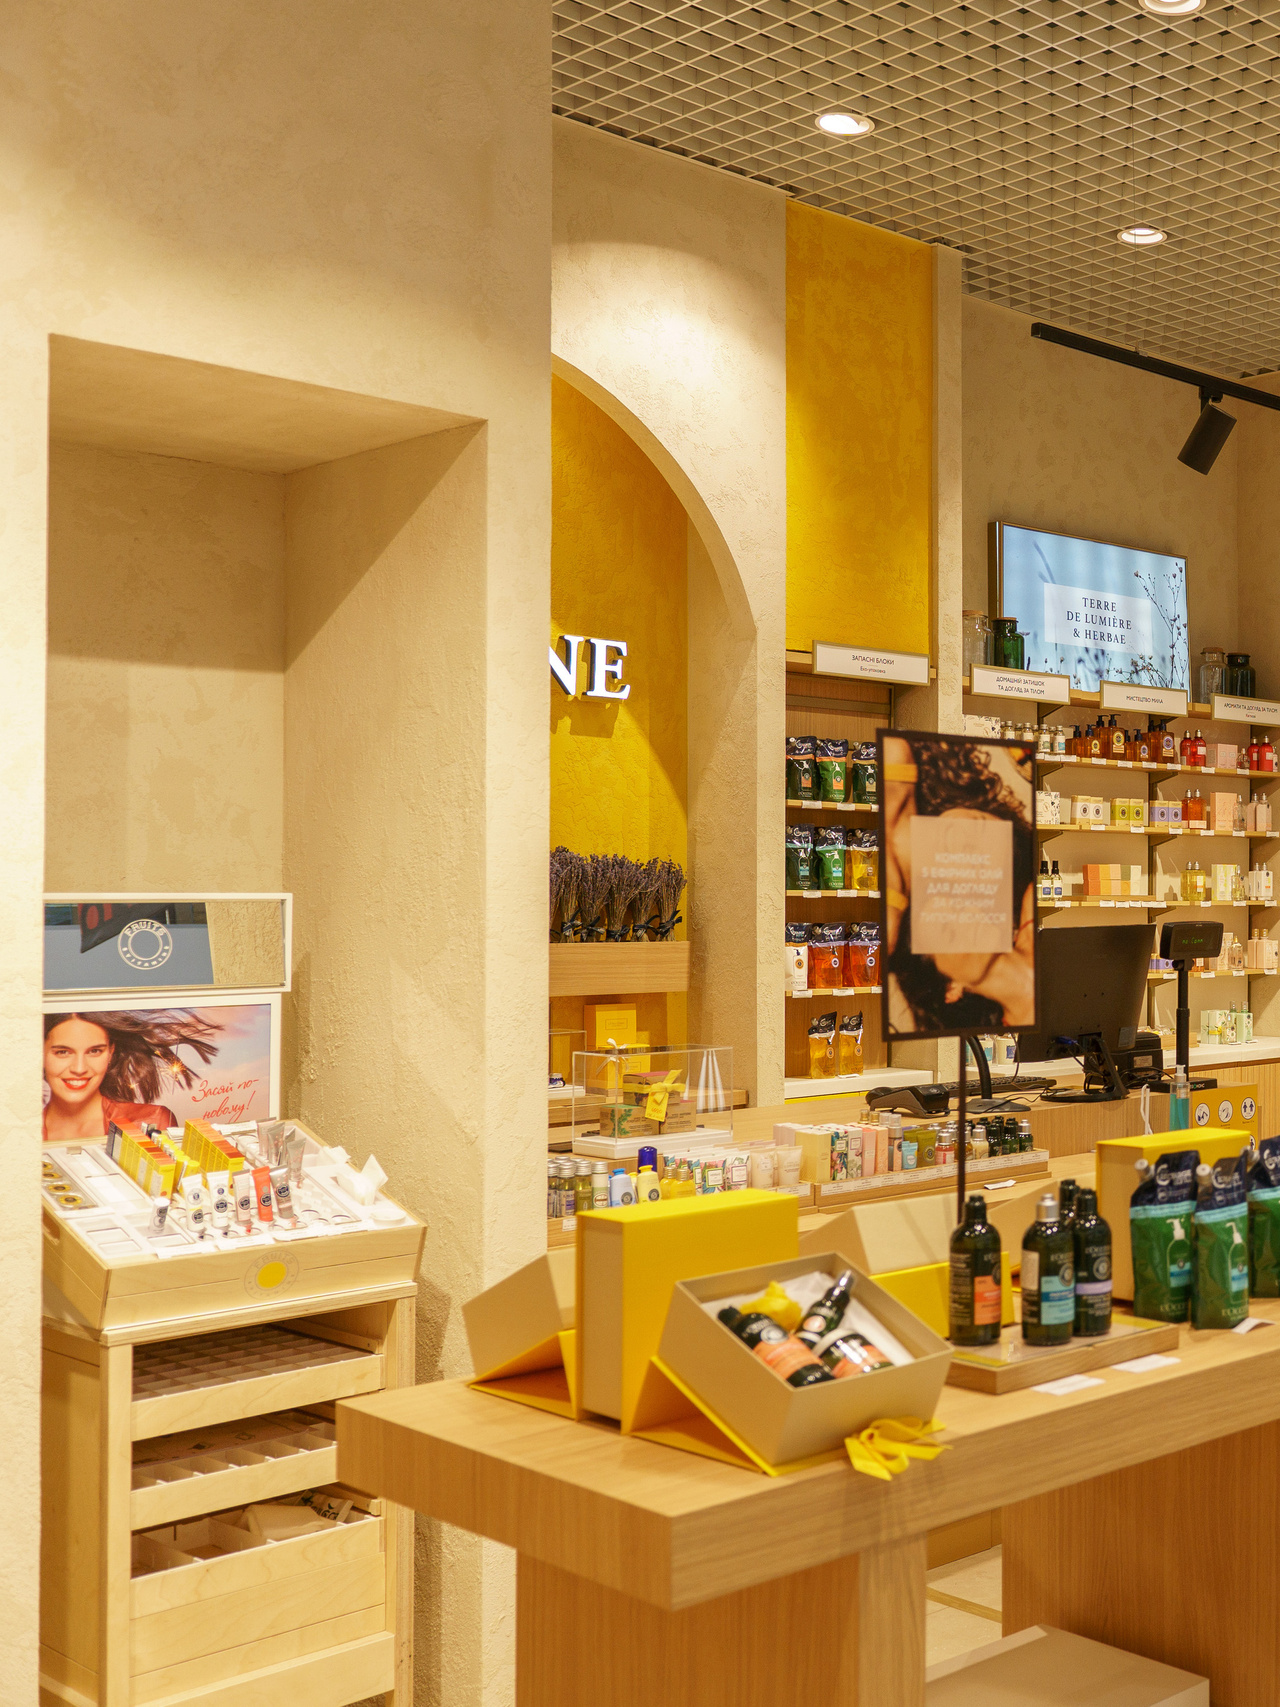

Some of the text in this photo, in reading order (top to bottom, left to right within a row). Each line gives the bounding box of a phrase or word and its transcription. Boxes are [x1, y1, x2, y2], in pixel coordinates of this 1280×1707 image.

[1082, 597, 1117, 612] TERRE
[1066, 611, 1132, 630] DE LUMIÈRE
[1073, 628, 1126, 644] & HERBAE
[852, 655, 894, 665] ЗАПАСНІ БЛОКИ
[996, 676, 1022, 684] ДОМАШНІЙ
[926, 882, 999, 895] ДЛЯ ДОГЛЯДУ
[124, 921, 166, 937] FRUITS
[191, 1079, 260, 1102] Засяй по-
[203, 1090, 256, 1123] новому!
